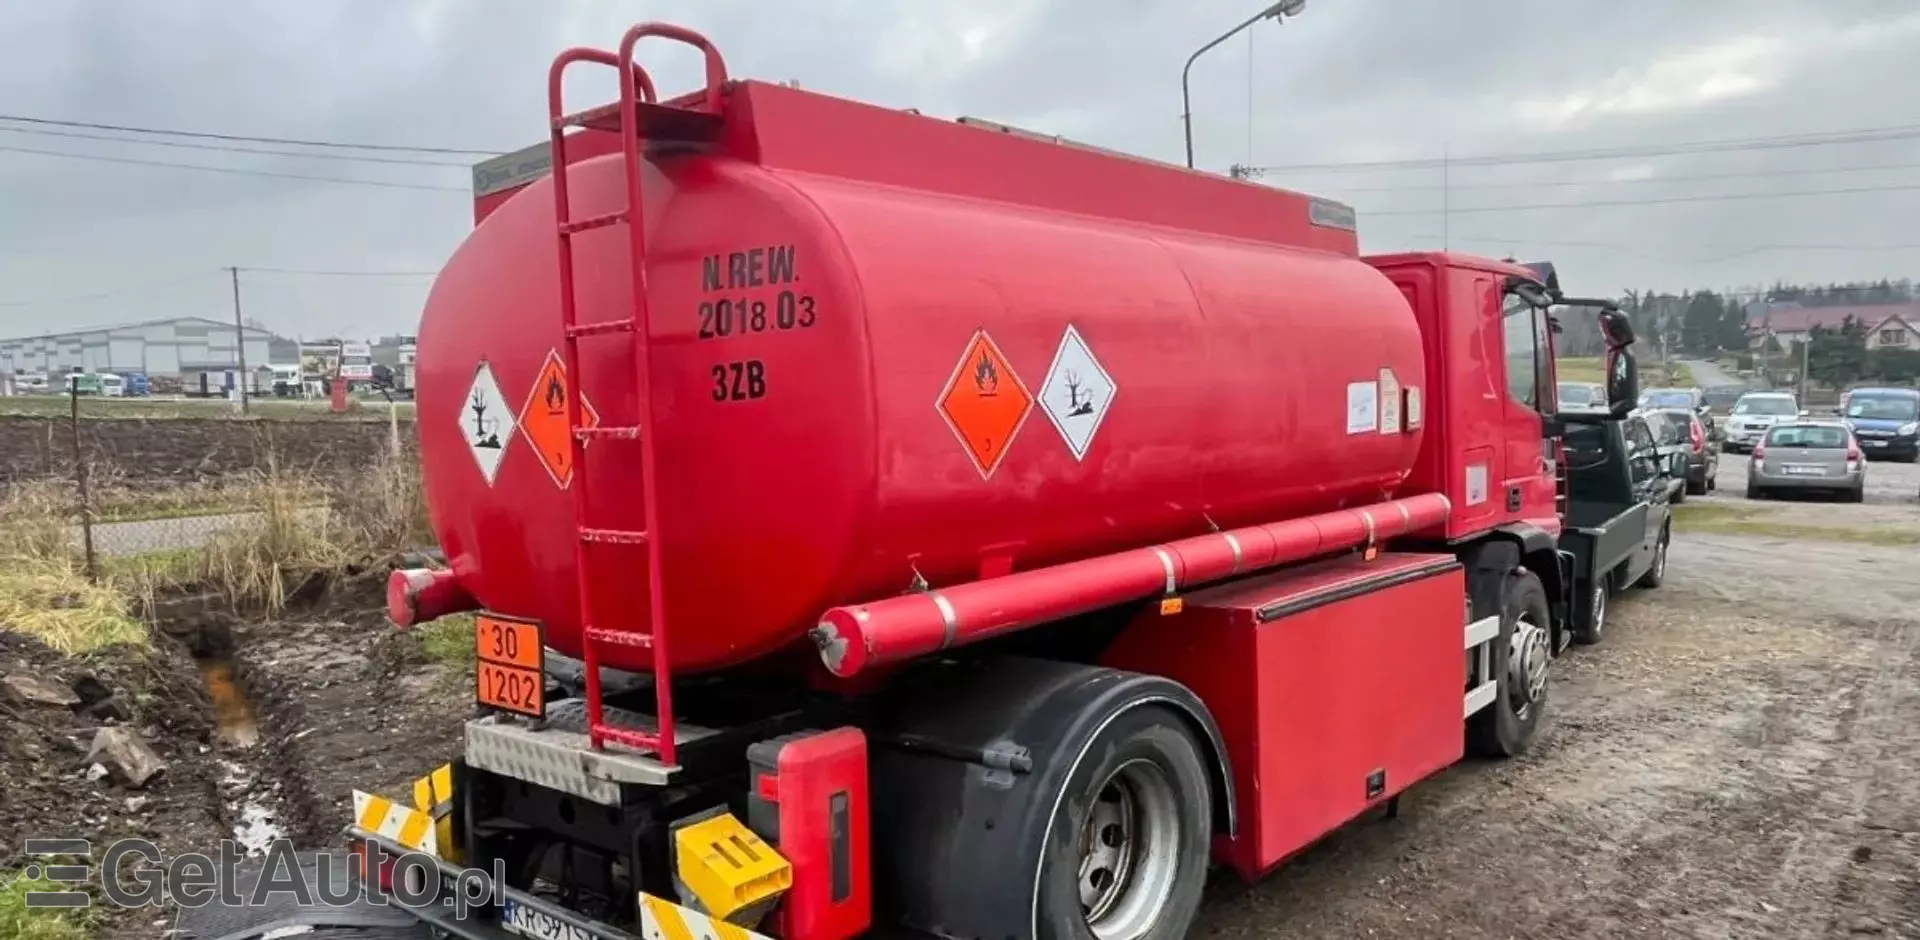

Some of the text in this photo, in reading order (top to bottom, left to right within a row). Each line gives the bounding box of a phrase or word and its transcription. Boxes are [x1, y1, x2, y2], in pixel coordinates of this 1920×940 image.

[698, 291, 816, 339] 2018.03
[711, 360, 766, 402] 3ZB
[491, 624, 518, 660] 30
[484, 667, 536, 709] 1202
